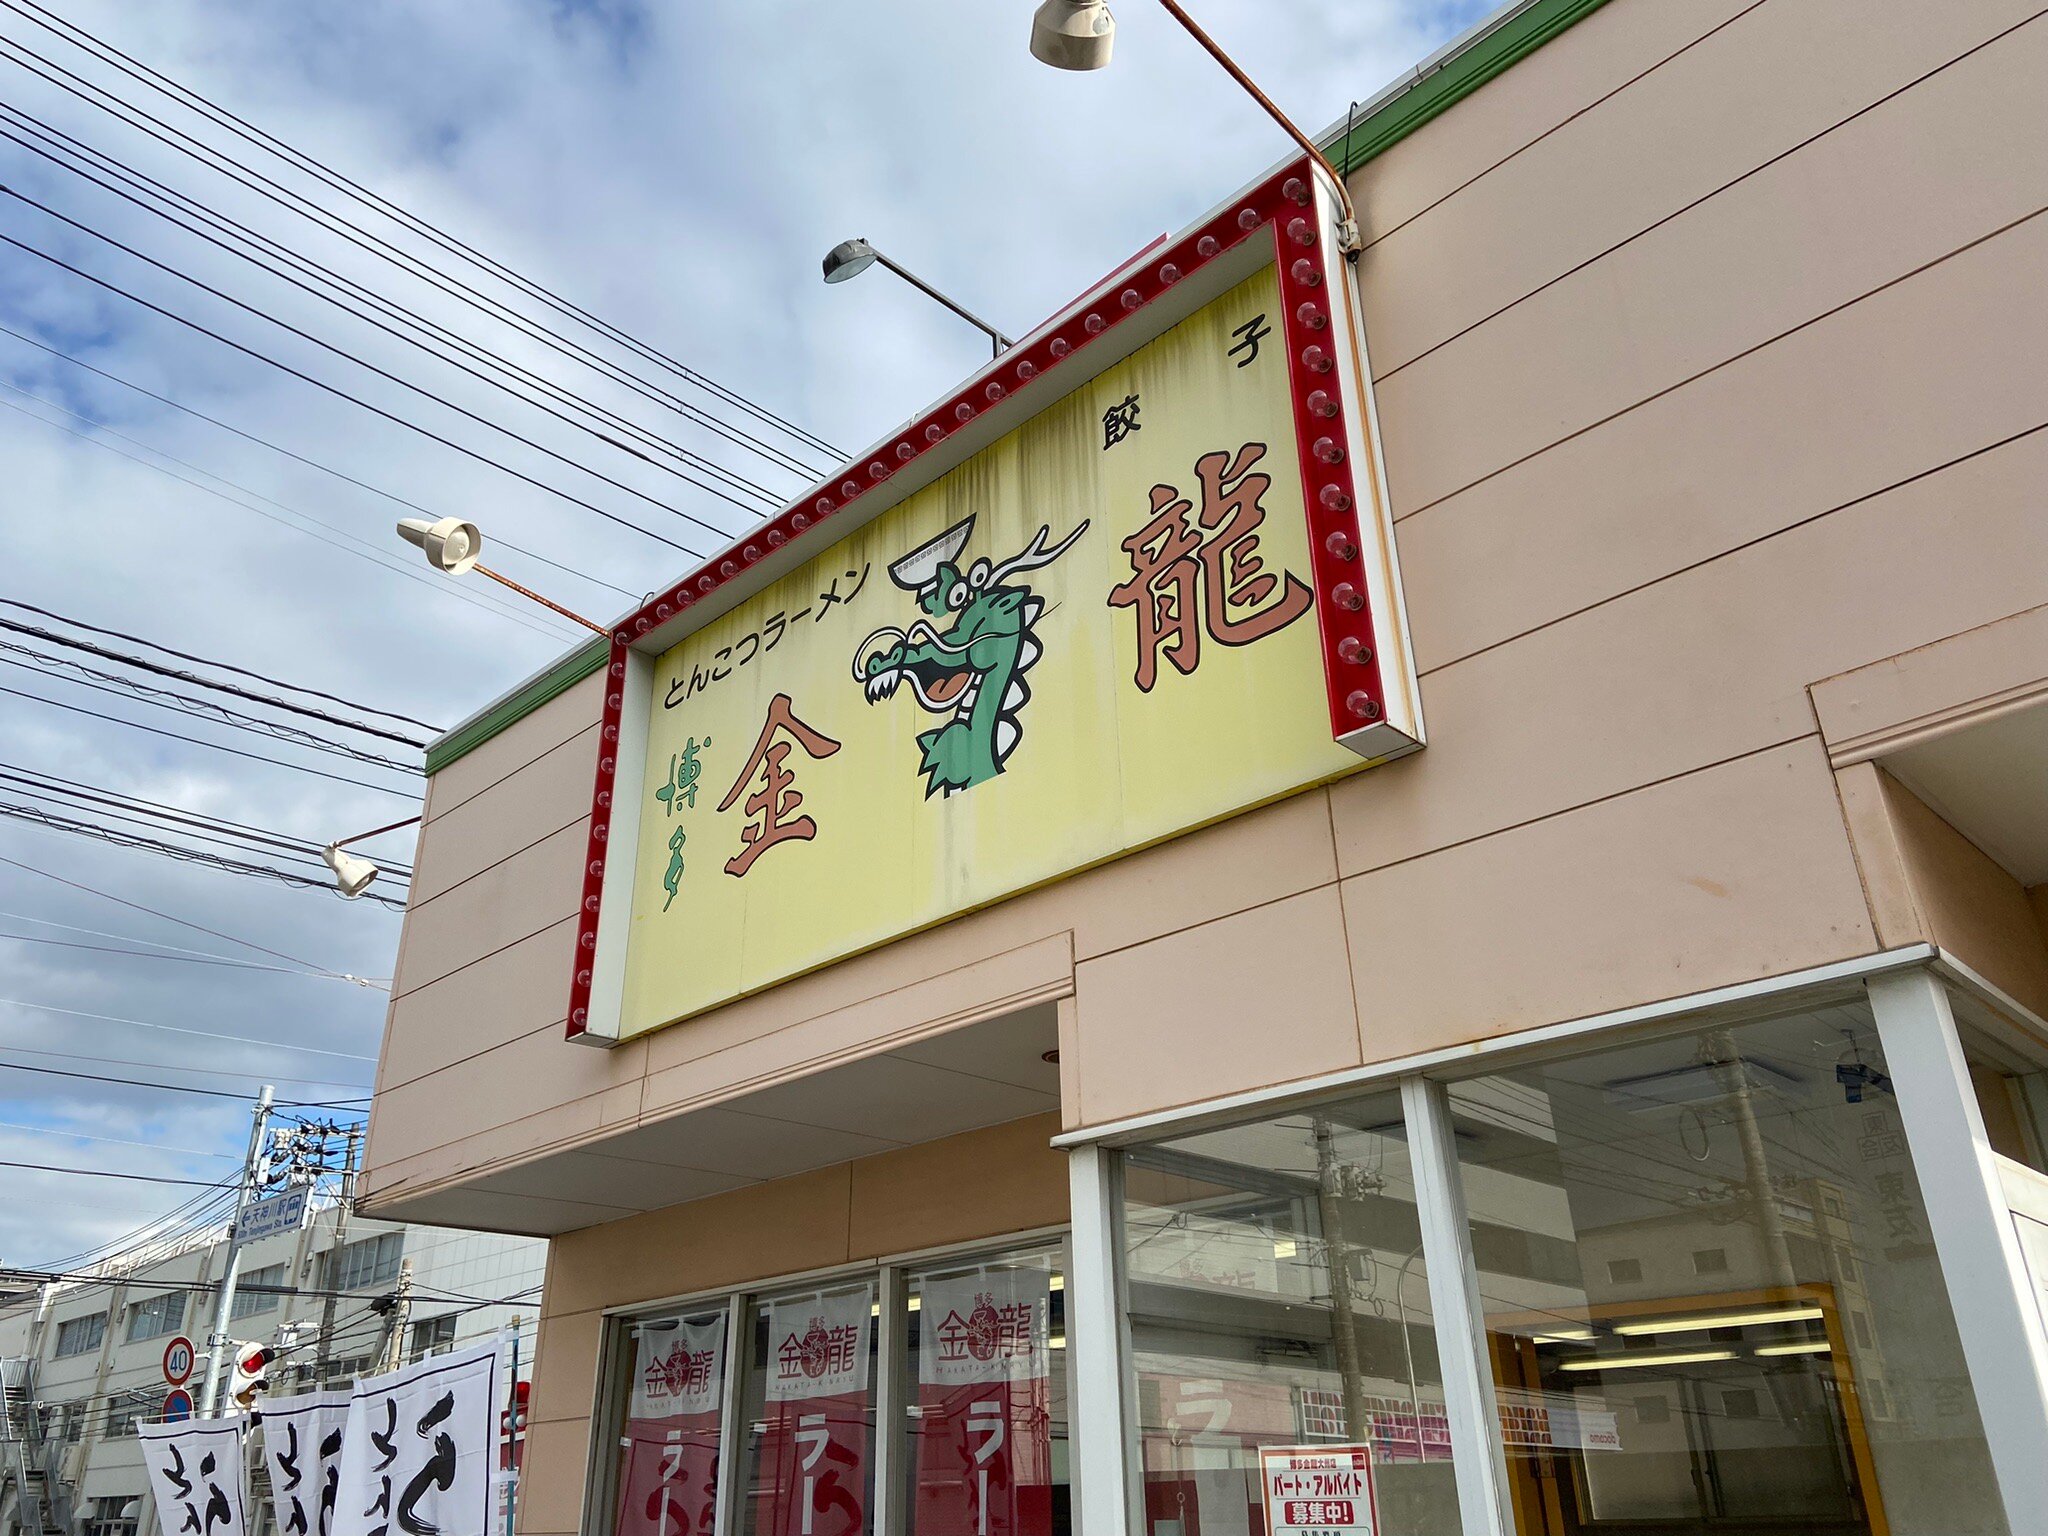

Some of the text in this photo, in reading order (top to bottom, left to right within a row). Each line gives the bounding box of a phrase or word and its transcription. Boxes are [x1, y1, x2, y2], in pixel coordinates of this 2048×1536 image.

[663, 561, 871, 710] とんこつラーメン
[716, 442, 1315, 877] 金 龍
[655, 736, 712, 913] 博多
[169, 1350, 187, 1372] 40
[778, 1324, 858, 1379] 金 龍
[937, 1310, 971, 1360] 金
